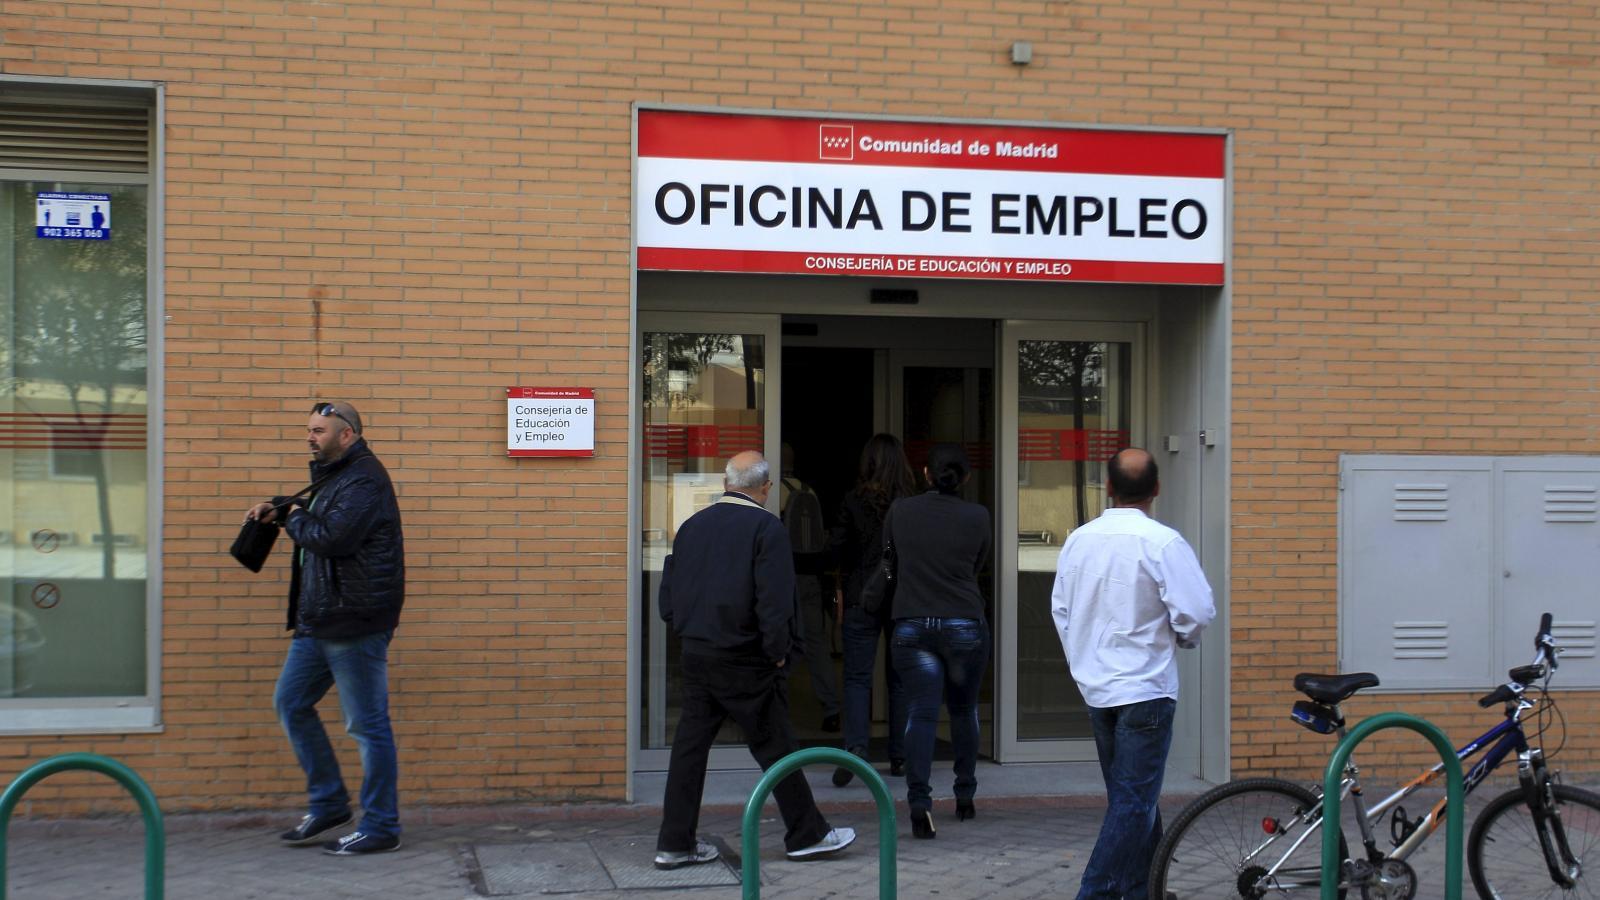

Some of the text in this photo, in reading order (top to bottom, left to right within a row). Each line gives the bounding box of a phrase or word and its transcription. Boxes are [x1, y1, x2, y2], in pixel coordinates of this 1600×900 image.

[858, 135, 1058, 159] Comunidad de Madrid
[654, 181, 1208, 241] OFICINA DE EMPLEO
[43, 228, 103, 238] 902 365 060
[805, 255, 1072, 276] CONSEJERÍA DE EDUCACIÓN Y EMPLEO
[575, 405, 588, 415] de
[515, 418, 570, 428] Educación
[515, 431, 565, 443] y Empleo
